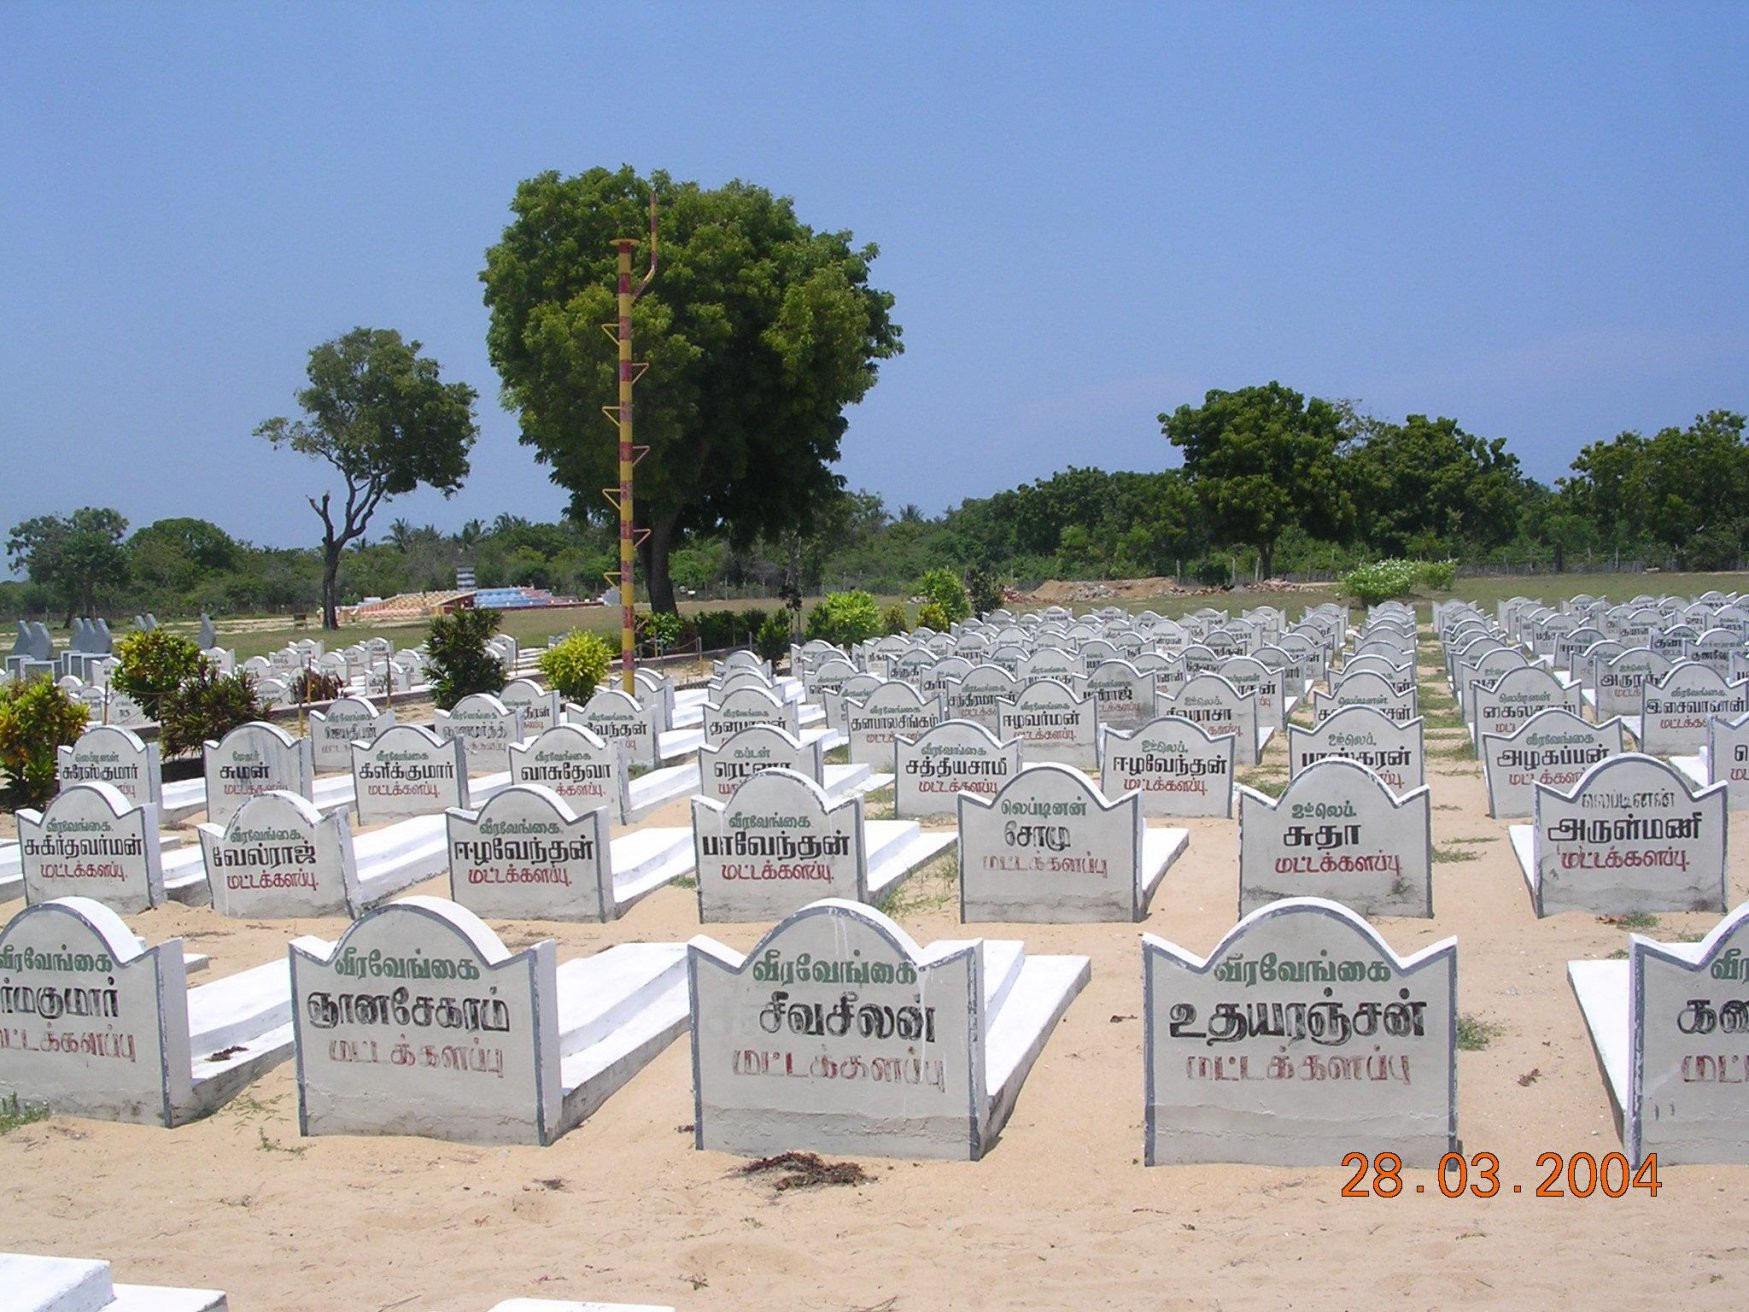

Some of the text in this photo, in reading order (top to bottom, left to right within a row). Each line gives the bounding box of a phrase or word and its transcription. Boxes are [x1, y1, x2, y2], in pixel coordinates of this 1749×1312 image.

[1002, 710, 1081, 730] ஈழவர்மன்
[219, 761, 270, 779] சுமன்
[520, 761, 611, 783] வாசுதேவா
[1113, 753, 1228, 777] ஈழவேந்தன்
[1496, 743, 1610, 772] அழகப்பன்
[1000, 796, 1088, 820] லெப்டினன்
[1004, 820, 1072, 851] சோமு
[1283, 824, 1362, 851] சுதா
[1547, 811, 1703, 844] அருள்மணி
[23, 833, 143, 860] சுகிர்தவர்மன்
[212, 840, 317, 869] வேல்ராஜ்
[454, 834, 594, 867] ஈழவேந்தன்
[702, 829, 851, 861] பாவேந்தன்
[0, 944, 113, 973] வீரவேங்கை
[334, 946, 481, 980] வீரவேங்கை
[752, 949, 918, 986] வீரவேங்கை
[1213, 949, 1392, 988] வீரவேங்கை
[306, 986, 511, 1033] ஞானசேகரம்
[1169, 986, 1428, 1048] உதயரஞ்சன்
[0, 1022, 137, 1063] ட்டக்களப்பு
[328, 1033, 505, 1079] மட்டக்களப்பு
[732, 1043, 947, 1094] மட்டக்களப்பு
[1185, 1045, 1412, 1086] மட்டக்களப்பு
